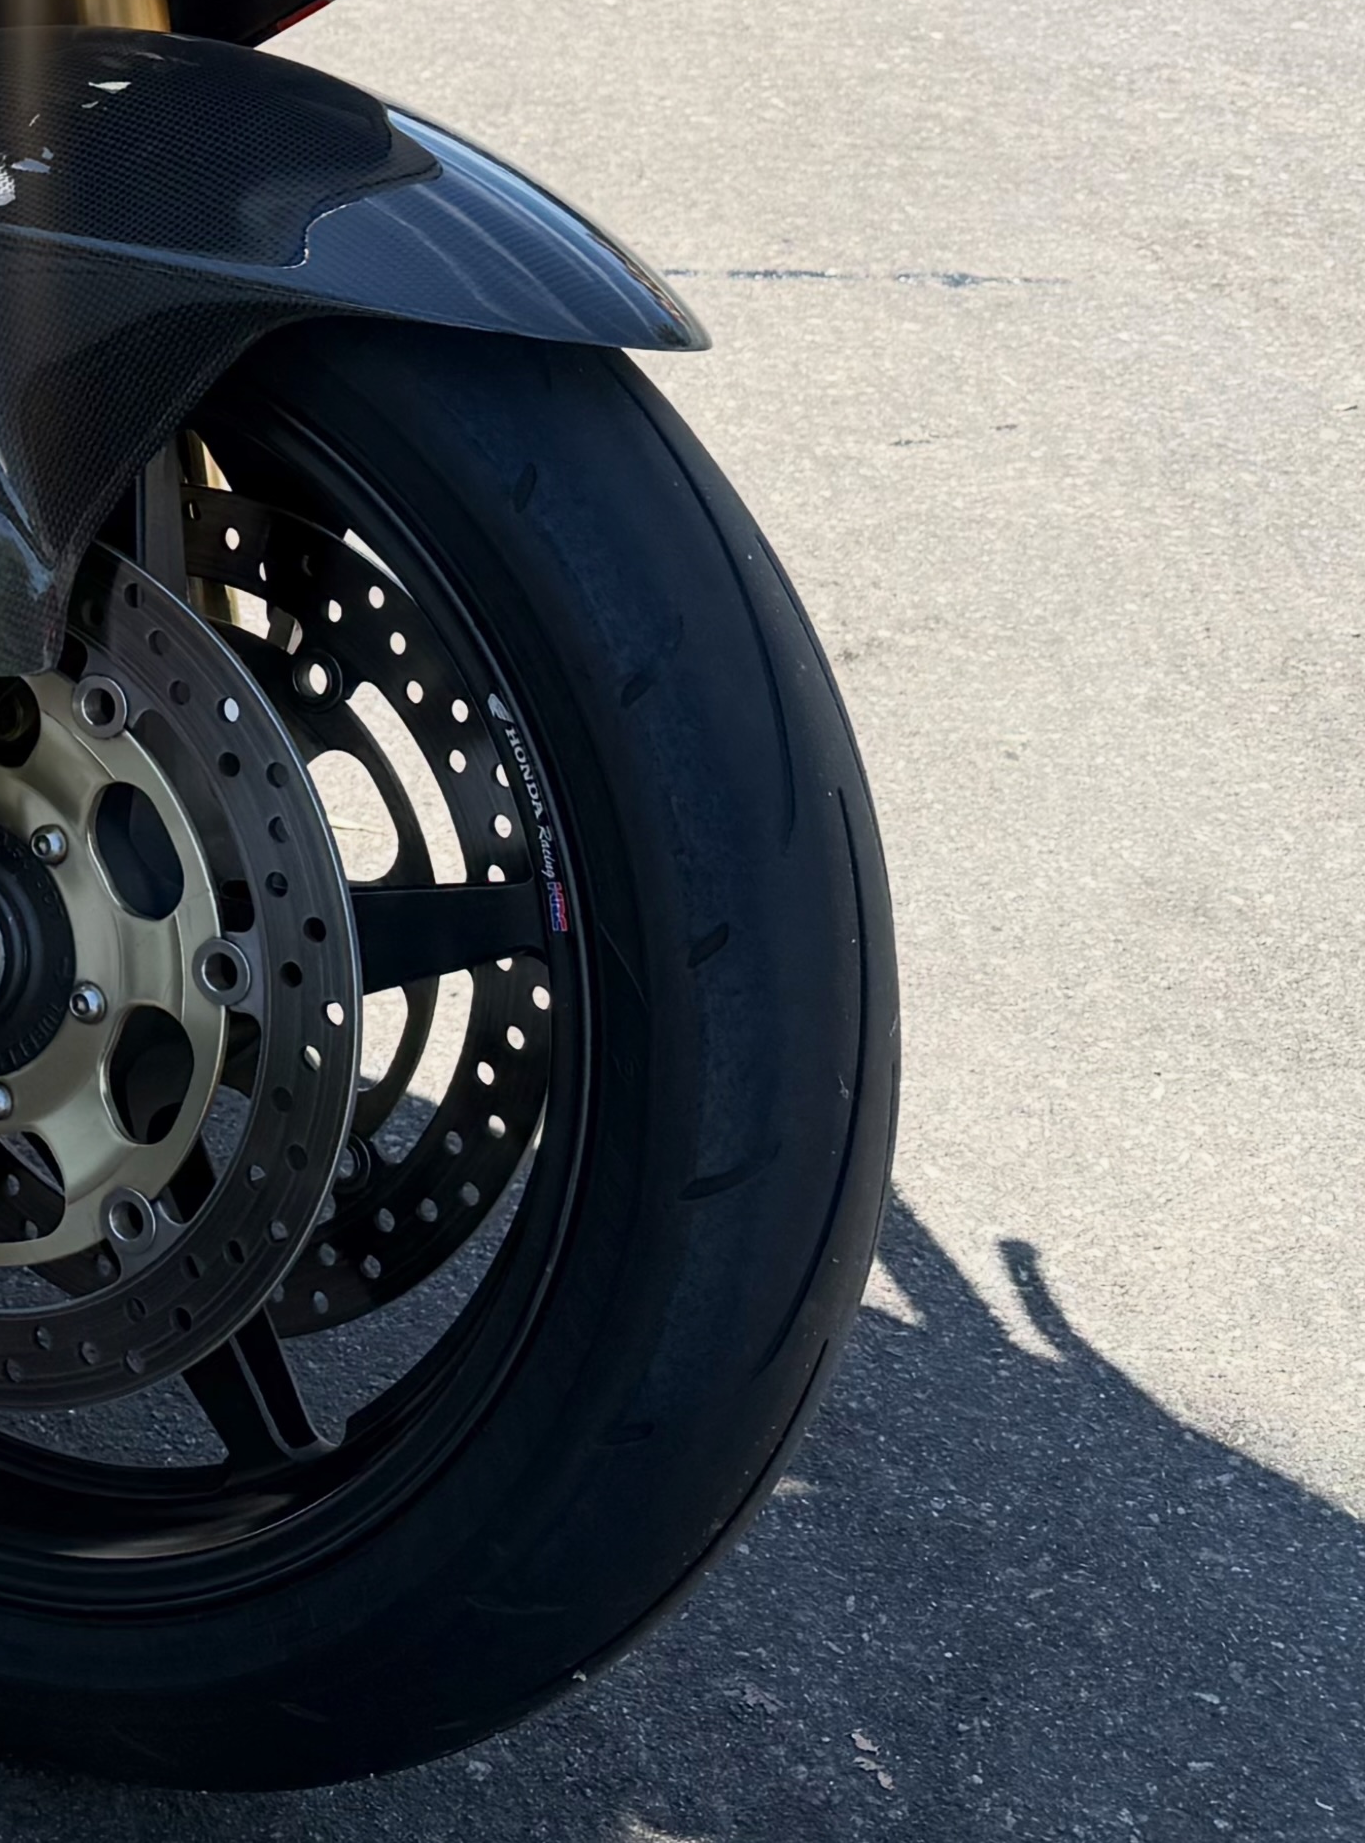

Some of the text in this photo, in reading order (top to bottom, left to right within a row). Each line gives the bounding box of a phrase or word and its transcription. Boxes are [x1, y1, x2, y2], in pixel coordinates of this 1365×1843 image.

[504, 729, 568, 932] HONDA Racing HRC
